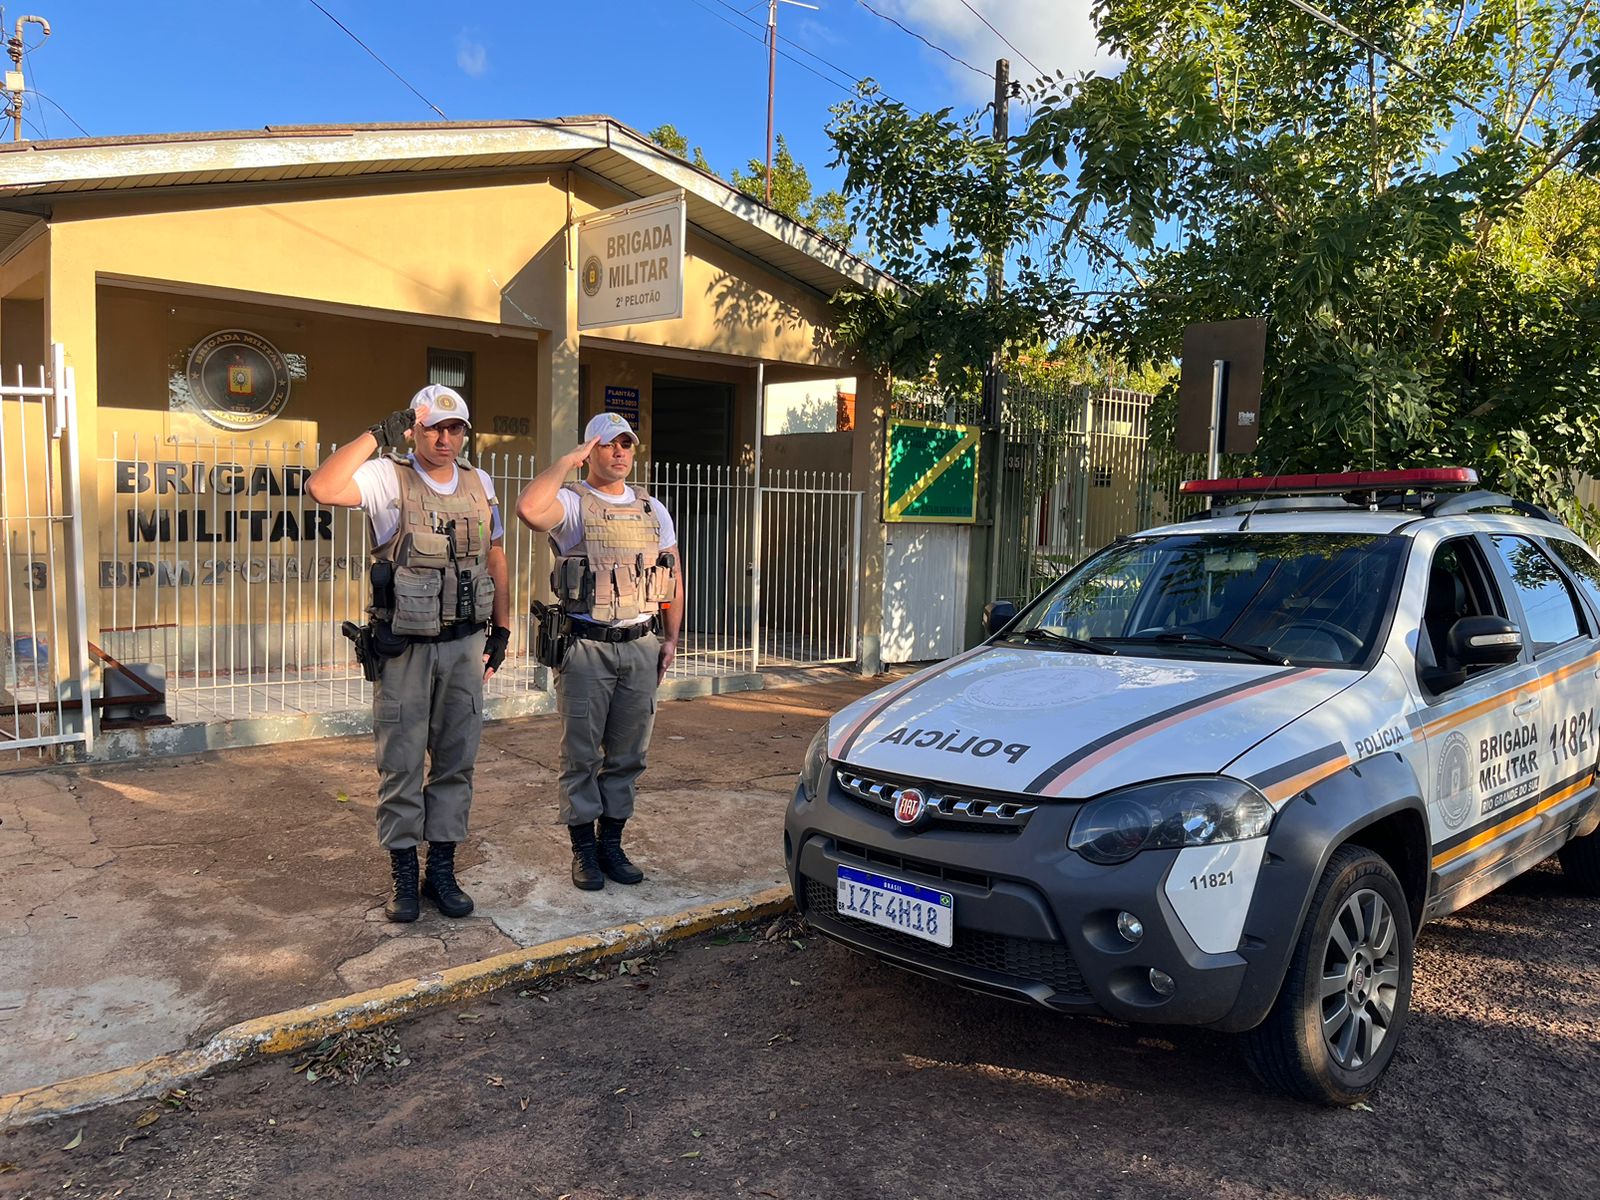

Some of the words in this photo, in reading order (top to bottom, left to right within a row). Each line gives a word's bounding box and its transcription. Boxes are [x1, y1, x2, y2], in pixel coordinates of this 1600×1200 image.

[607, 224, 672, 259] BRIGADA
[609, 257, 668, 289] MILITAR
[625, 289, 661, 307] PELOTÃO
[195, 333, 240, 365] BRIGADA
[243, 335, 282, 371] MILITAR
[269, 392, 285, 411] SUL
[116, 460, 311, 497] BRIGAD
[128, 509, 333, 543] MILITAR
[1354, 726, 1405, 759] POLÍCIA
[1479, 722, 1538, 764] BRIGADA
[1549, 706, 1595, 766] 11821
[1478, 750, 1539, 793] MILITAR
[899, 798, 918, 816] FIAT
[883, 881, 902, 892] BRASIL
[1190, 870, 1233, 890] 11821
[847, 884, 939, 936] IZF4H18
